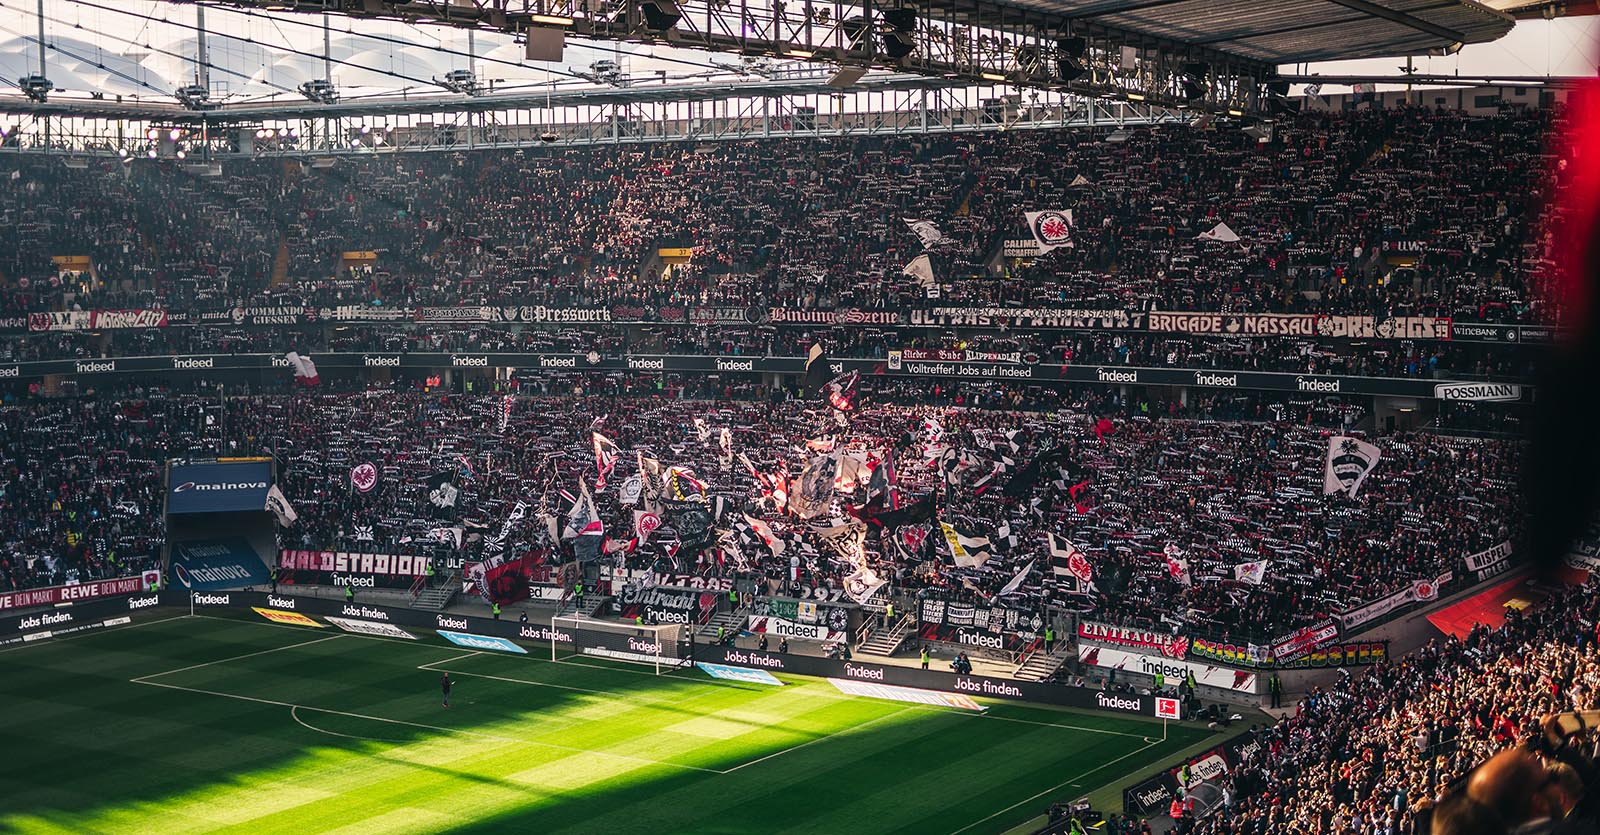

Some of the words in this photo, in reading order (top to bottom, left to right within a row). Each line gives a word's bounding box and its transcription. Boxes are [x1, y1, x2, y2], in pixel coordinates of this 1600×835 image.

[167, 311, 187, 320] west
[202, 310, 231, 321] united
[245, 307, 304, 316] COMMANDO
[769, 307, 836, 324] Binding
[846, 308, 897, 324] Szene
[253, 315, 298, 325] GIESSEN
[1148, 315, 1221, 332] BRIGADE
[1243, 318, 1312, 335] NASSAU
[1436, 325, 1449, 338] 99
[172, 355, 213, 369] indeed
[363, 354, 400, 366] indeed
[451, 354, 487, 366] indeed
[540, 354, 576, 367] indeed
[628, 356, 664, 370] indeed
[965, 350, 1021, 362] KLIPPENADLER
[75, 359, 116, 375] indeed
[715, 358, 753, 371] indeed
[907, 363, 955, 375] Volltreffer!
[957, 365, 981, 377] Jobs
[982, 366, 997, 377] auf
[999, 367, 1032, 378] Indeed
[1096, 367, 1137, 382] indeed
[1194, 371, 1237, 387] indeed
[1296, 376, 1339, 391] indeed
[1443, 384, 1513, 399] POSSMANN
[196, 481, 268, 491] mainova
[1472, 546, 1507, 568] MISPEL
[191, 564, 252, 584] mainova
[331, 571, 375, 588] indeed
[15, 592, 32, 605] DEIN
[33, 589, 54, 604] MARKT
[61, 584, 98, 602] REWE
[101, 585, 118, 598] DEIN
[121, 580, 140, 595] MARKT
[193, 592, 230, 606] indeed
[129, 594, 159, 609] indeed
[267, 595, 295, 609] indeed
[18, 616, 40, 629] Jobs
[42, 612, 73, 626] finden.
[342, 605, 362, 618] Jobs
[362, 608, 390, 622] finden.
[647, 605, 689, 624] indeed
[437, 615, 467, 630] indeed
[775, 619, 818, 639] indeed
[520, 626, 541, 639] Jobs
[542, 630, 573, 643] finden.
[957, 626, 1003, 650] indeed
[1083, 622, 1173, 647] EINTRACHT
[627, 637, 662, 654] indeed
[725, 650, 748, 664] Jobs
[750, 654, 785, 668] finden.
[1140, 655, 1188, 679] indeed
[843, 663, 884, 680] indeed
[954, 677, 981, 691] Jobs
[983, 680, 1023, 697] finden.
[1096, 692, 1141, 711] indeed
[1137, 785, 1170, 807] indeed
